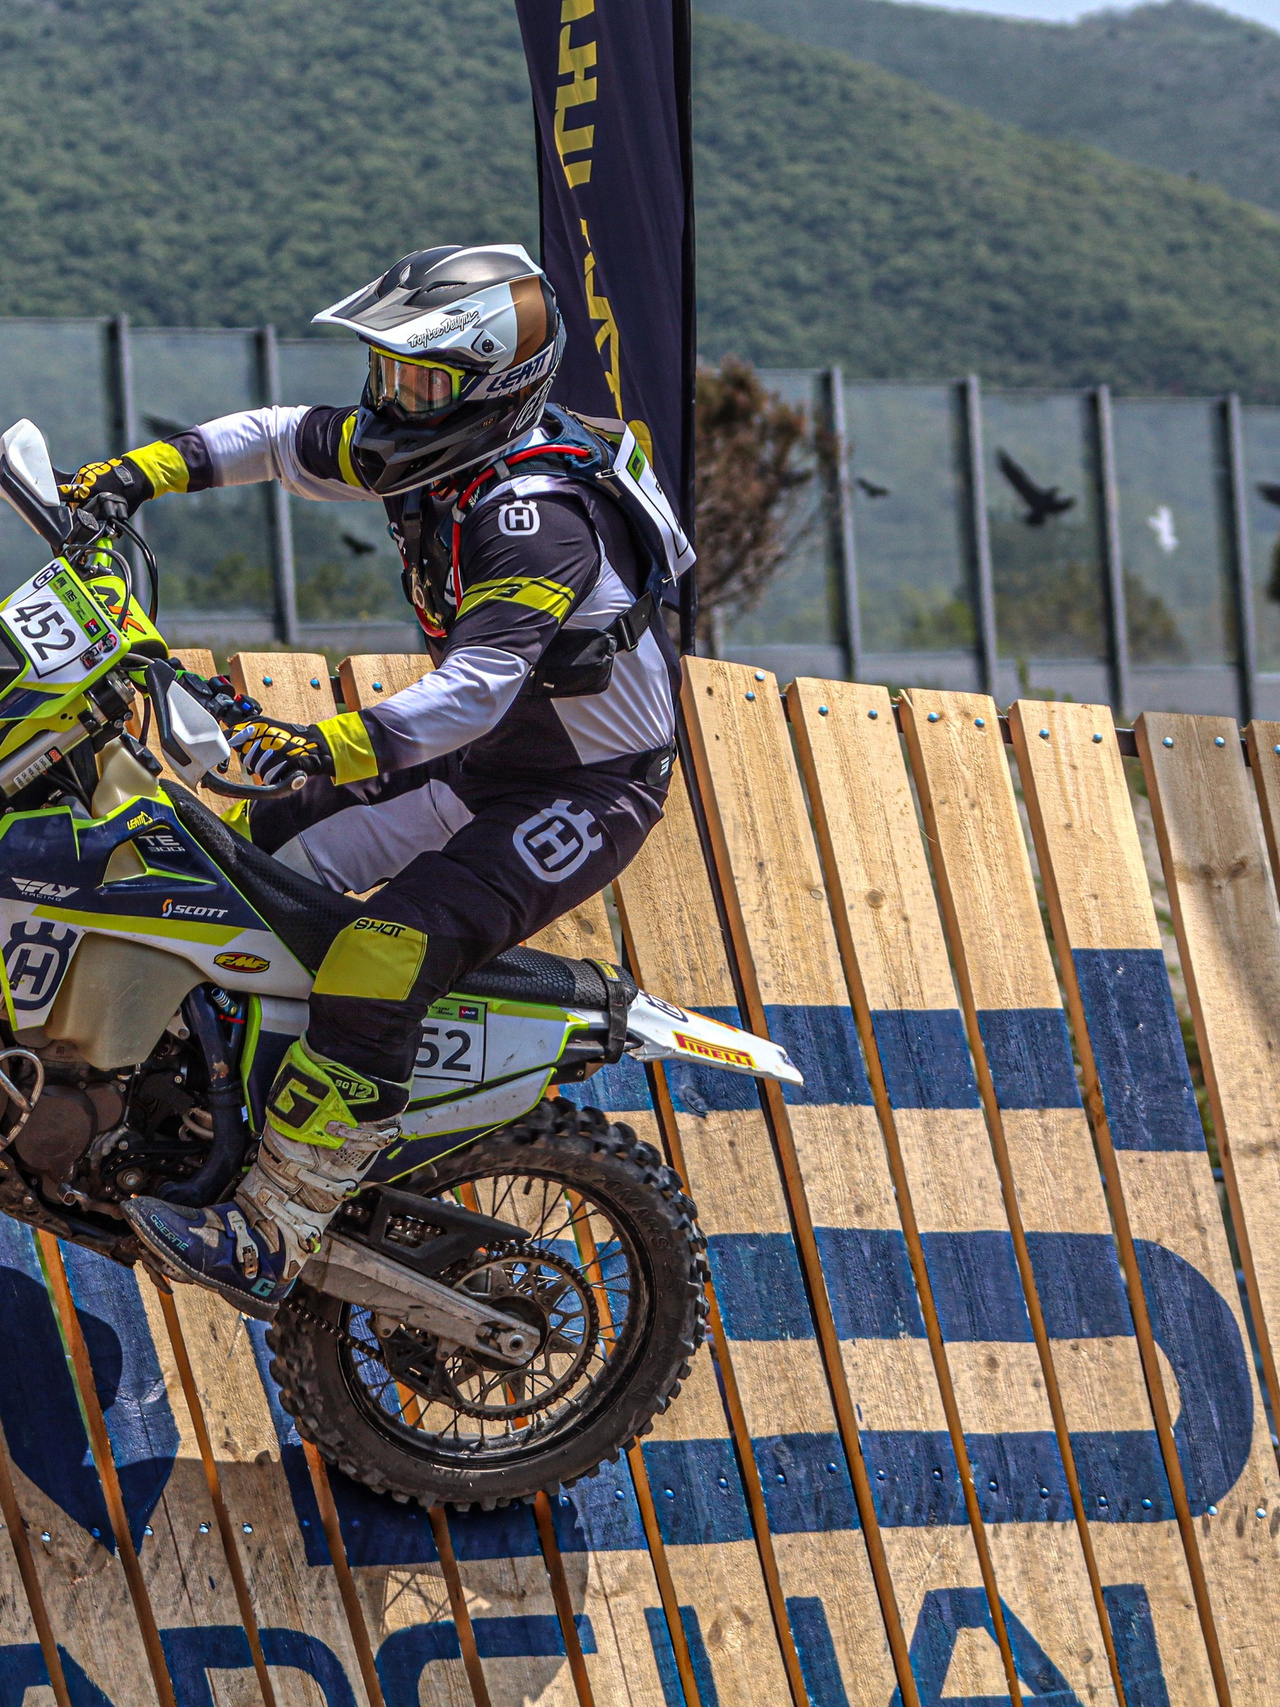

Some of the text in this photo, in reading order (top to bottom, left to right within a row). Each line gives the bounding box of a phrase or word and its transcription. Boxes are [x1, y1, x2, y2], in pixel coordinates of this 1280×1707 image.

[12, 600, 78, 662] 452
[138, 835, 181, 847] TE
[11, 876, 81, 899] FLY
[21, 890, 62, 903] RACING
[172, 904, 229, 919] SCOTT
[353, 917, 408, 939] SHOT
[216, 954, 270, 973] FMF
[415, 1025, 473, 1073] 52
[674, 1032, 755, 1068] PIRELLI
